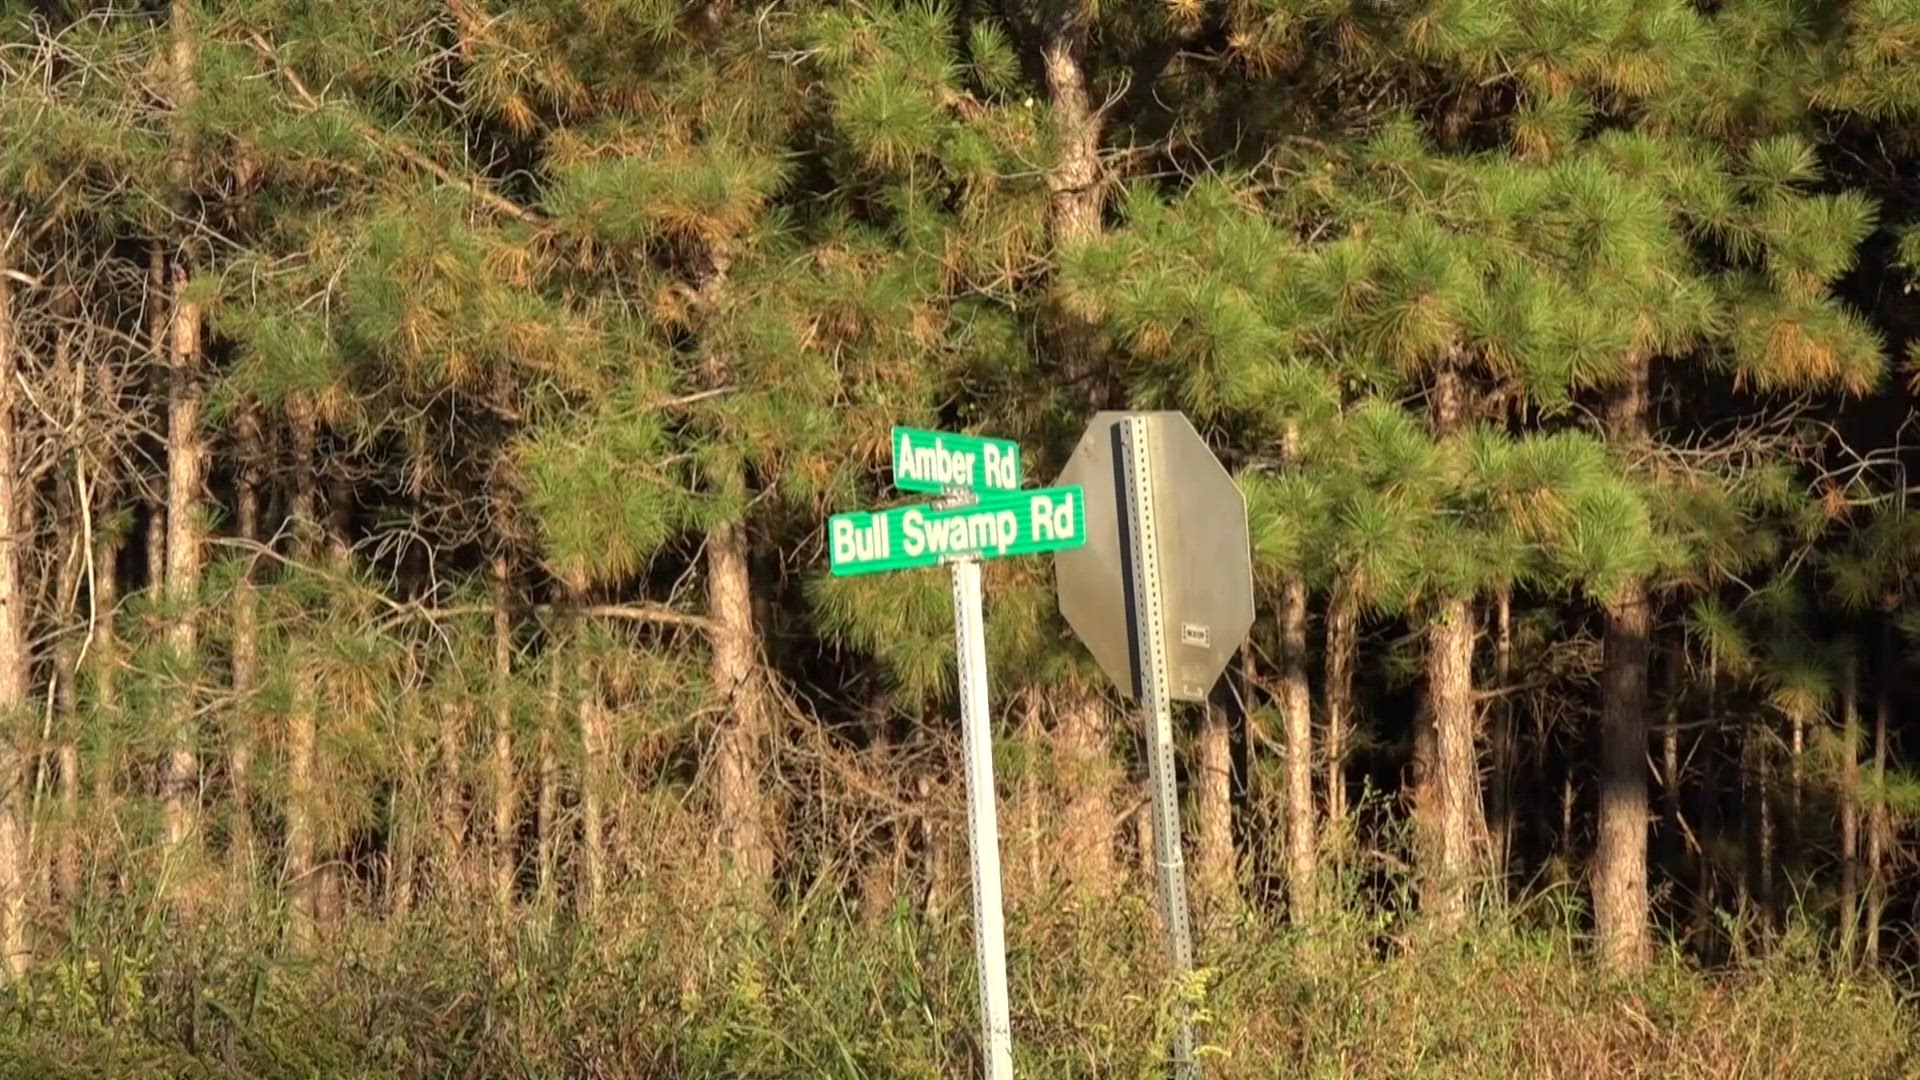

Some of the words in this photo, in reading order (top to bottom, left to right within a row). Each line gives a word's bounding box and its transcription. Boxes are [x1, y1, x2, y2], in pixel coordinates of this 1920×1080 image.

[900, 434, 976, 485] Amber
[983, 443, 1017, 489] Rd
[832, 513, 890, 564] Bull
[902, 509, 1018, 556] Swamp
[1030, 492, 1075, 541] Rd
